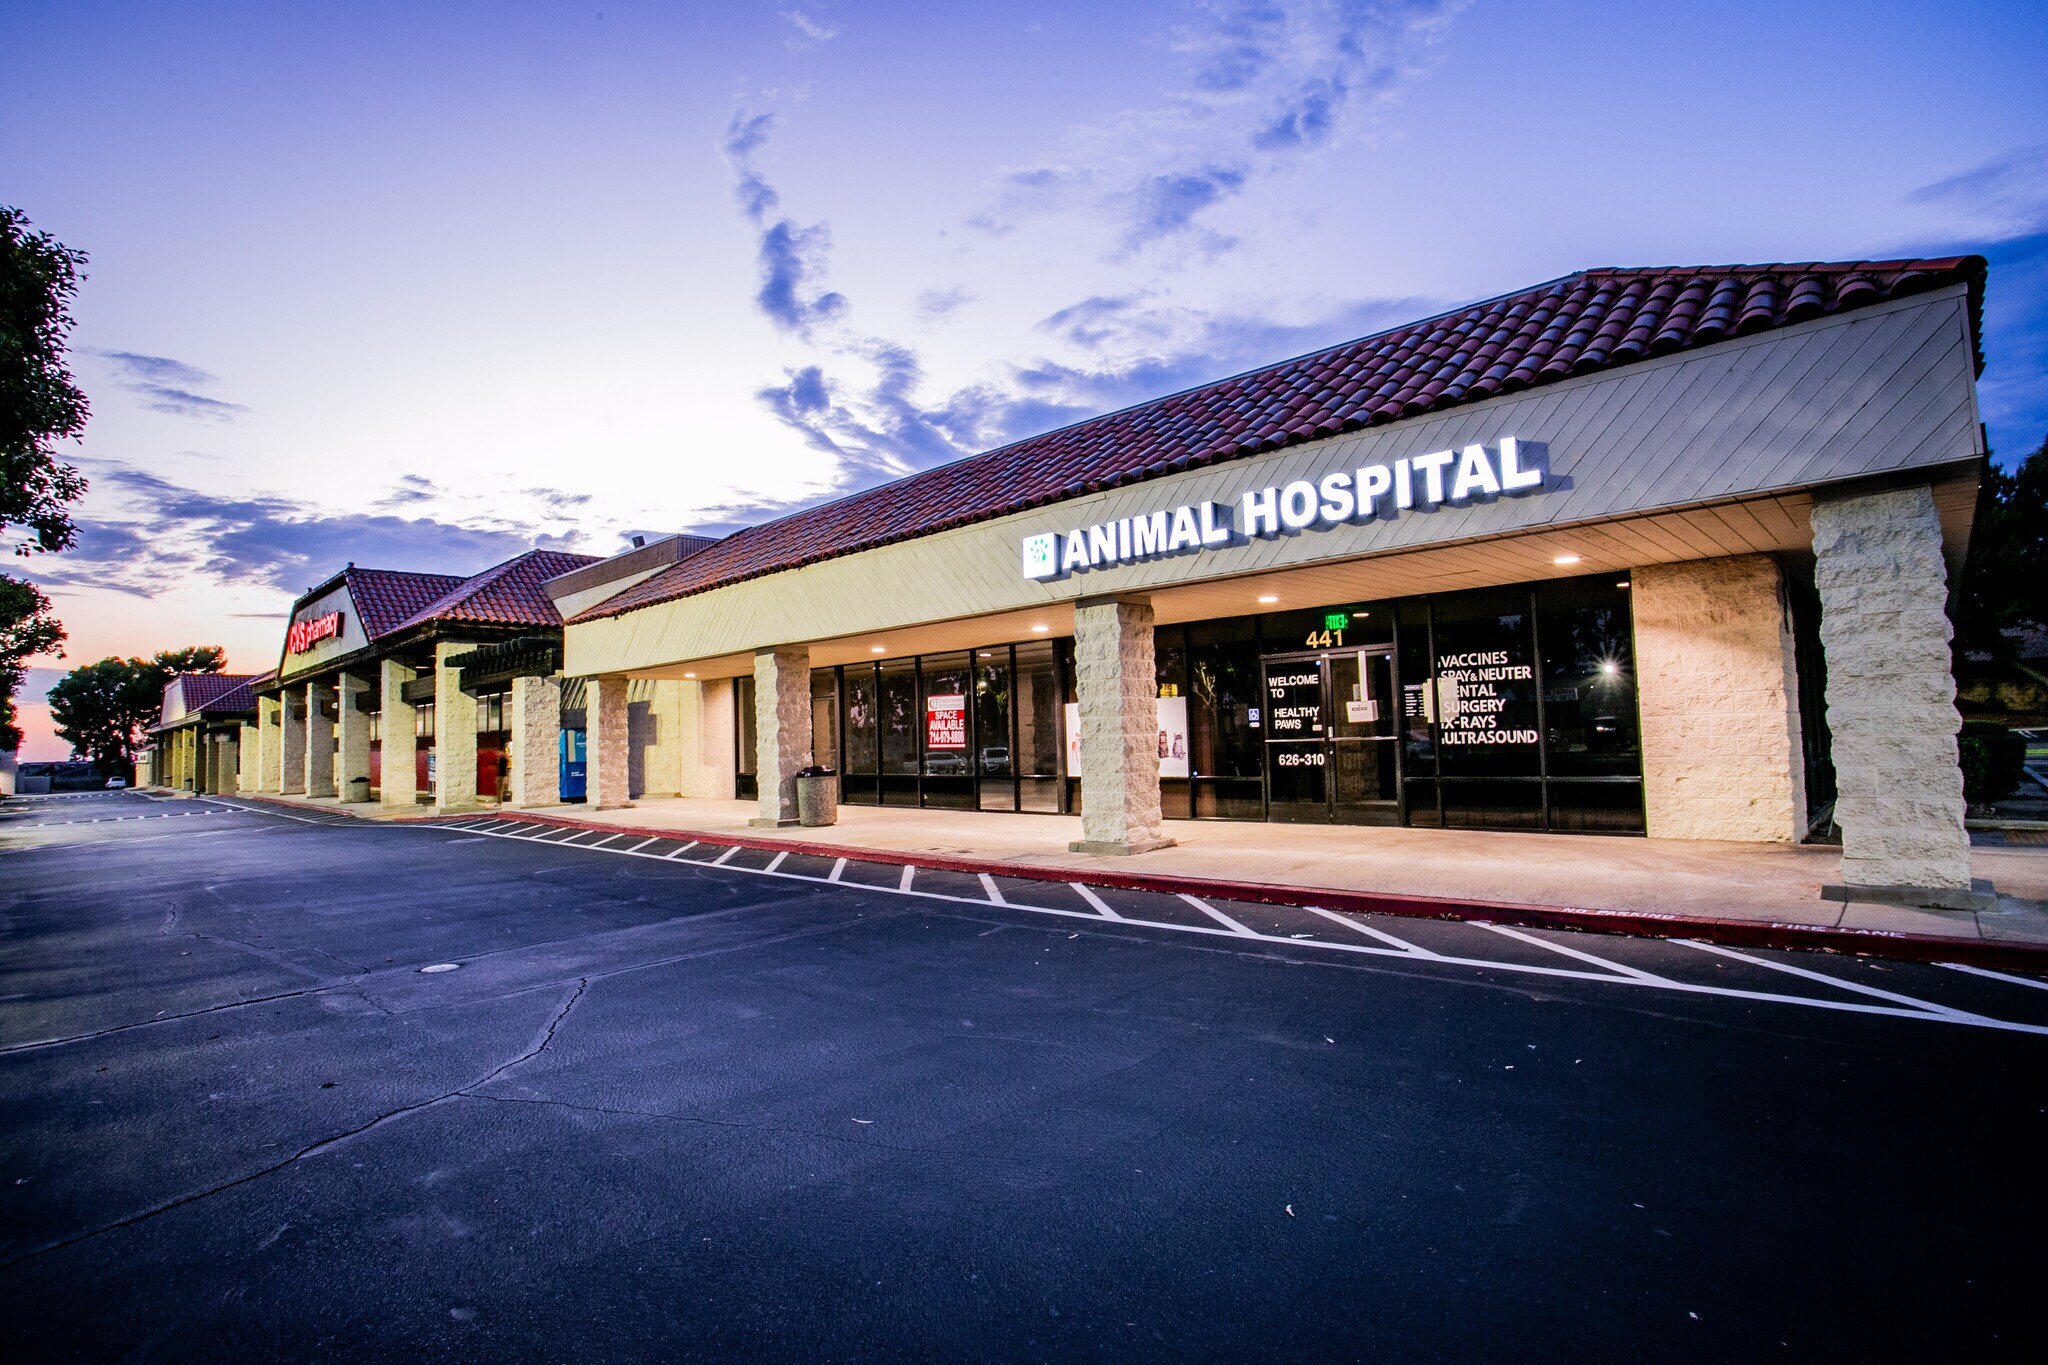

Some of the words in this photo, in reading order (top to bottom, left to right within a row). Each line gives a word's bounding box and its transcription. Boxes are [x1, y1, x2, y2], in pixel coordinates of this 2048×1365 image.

[1062, 500, 1229, 570] ANIMAL
[1242, 437, 1542, 537] HOSPITAL
[288, 621, 306, 655] CVS
[305, 611, 339, 649] pharmacy
[1305, 628, 1343, 648] 441
[1440, 651, 1508, 668] VACCINES
[1268, 674, 1319, 687] WELCOME
[1440, 669, 1471, 683] SPAY
[1478, 665, 1532, 682] NEUTER
[1270, 688, 1285, 699] TO
[1274, 706, 1320, 718] HEALTHY
[1444, 698, 1506, 714] SURGERY
[935, 710, 957, 720] SPACE
[1444, 714, 1497, 730] X-RAYS
[929, 719, 964, 731] AVAILABLE
[1275, 719, 1302, 730] PAWS
[1444, 730, 1538, 745] ULTRASOUND
[1279, 753, 1325, 766] 626-310
[1596, 909, 1676, 920] PARKING
[1772, 922, 1827, 932] FIRE
[1839, 928, 1906, 939] LANE
